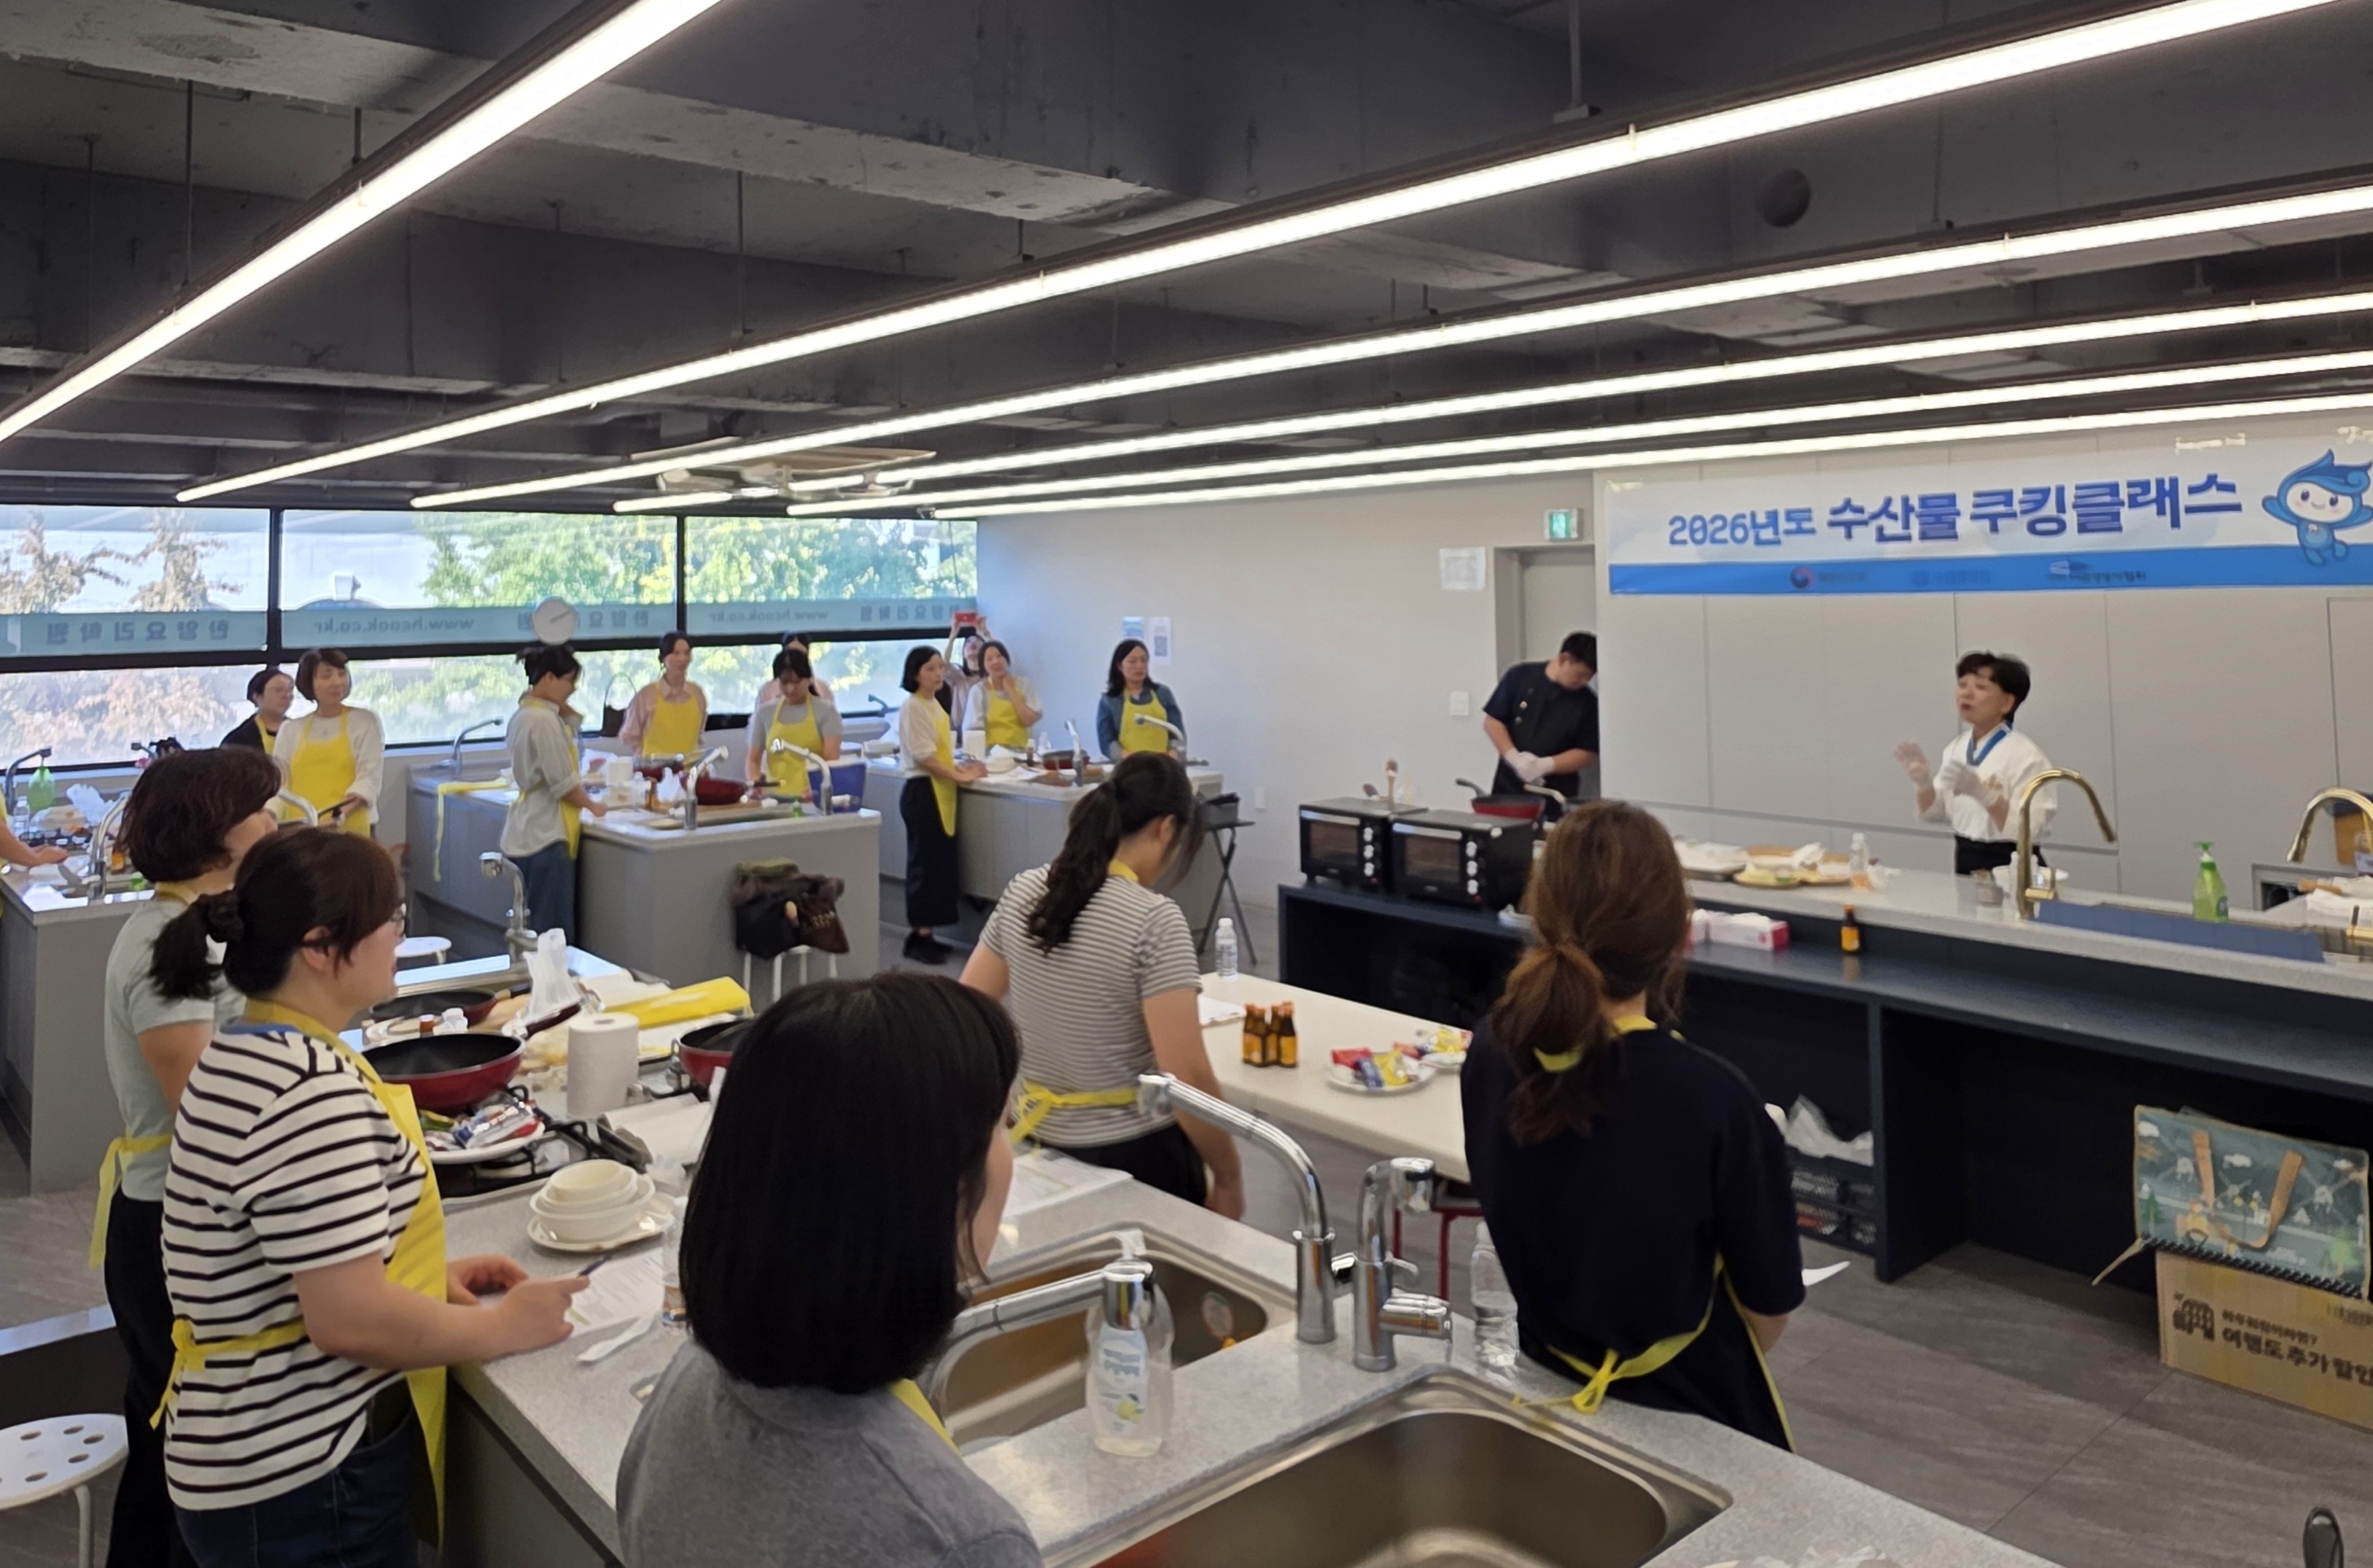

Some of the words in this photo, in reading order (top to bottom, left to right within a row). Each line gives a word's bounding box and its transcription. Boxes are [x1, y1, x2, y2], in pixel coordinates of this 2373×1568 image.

[1668, 506, 1817, 546] 2026년도
[1827, 494, 1961, 543] 수산물
[1969, 473, 2242, 537] 쿠킹클래스
